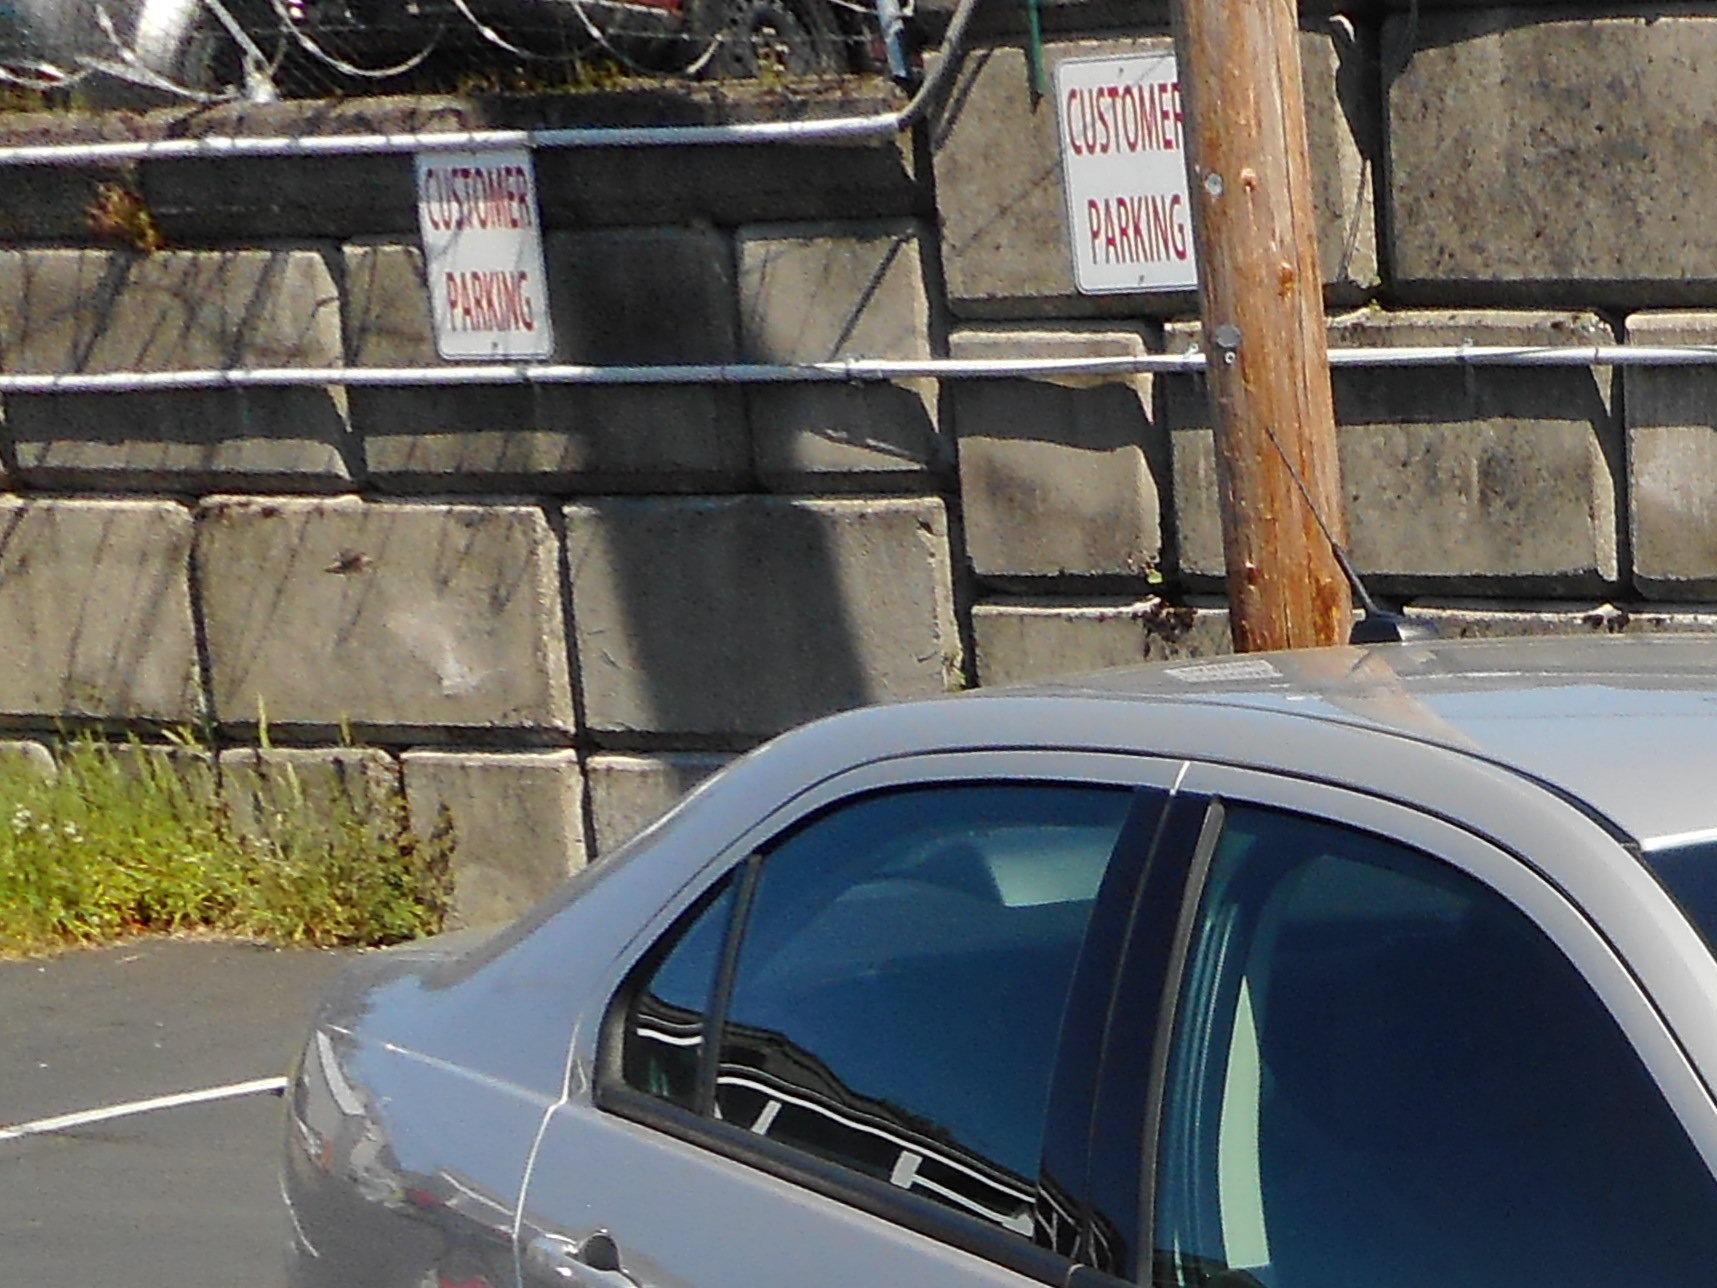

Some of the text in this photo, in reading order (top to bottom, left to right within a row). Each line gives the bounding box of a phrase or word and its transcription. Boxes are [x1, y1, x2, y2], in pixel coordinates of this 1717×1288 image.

[425, 167, 533, 231] CUSTOMER
[1087, 194, 1187, 265] PARKING
[445, 271, 534, 332] PARKING
